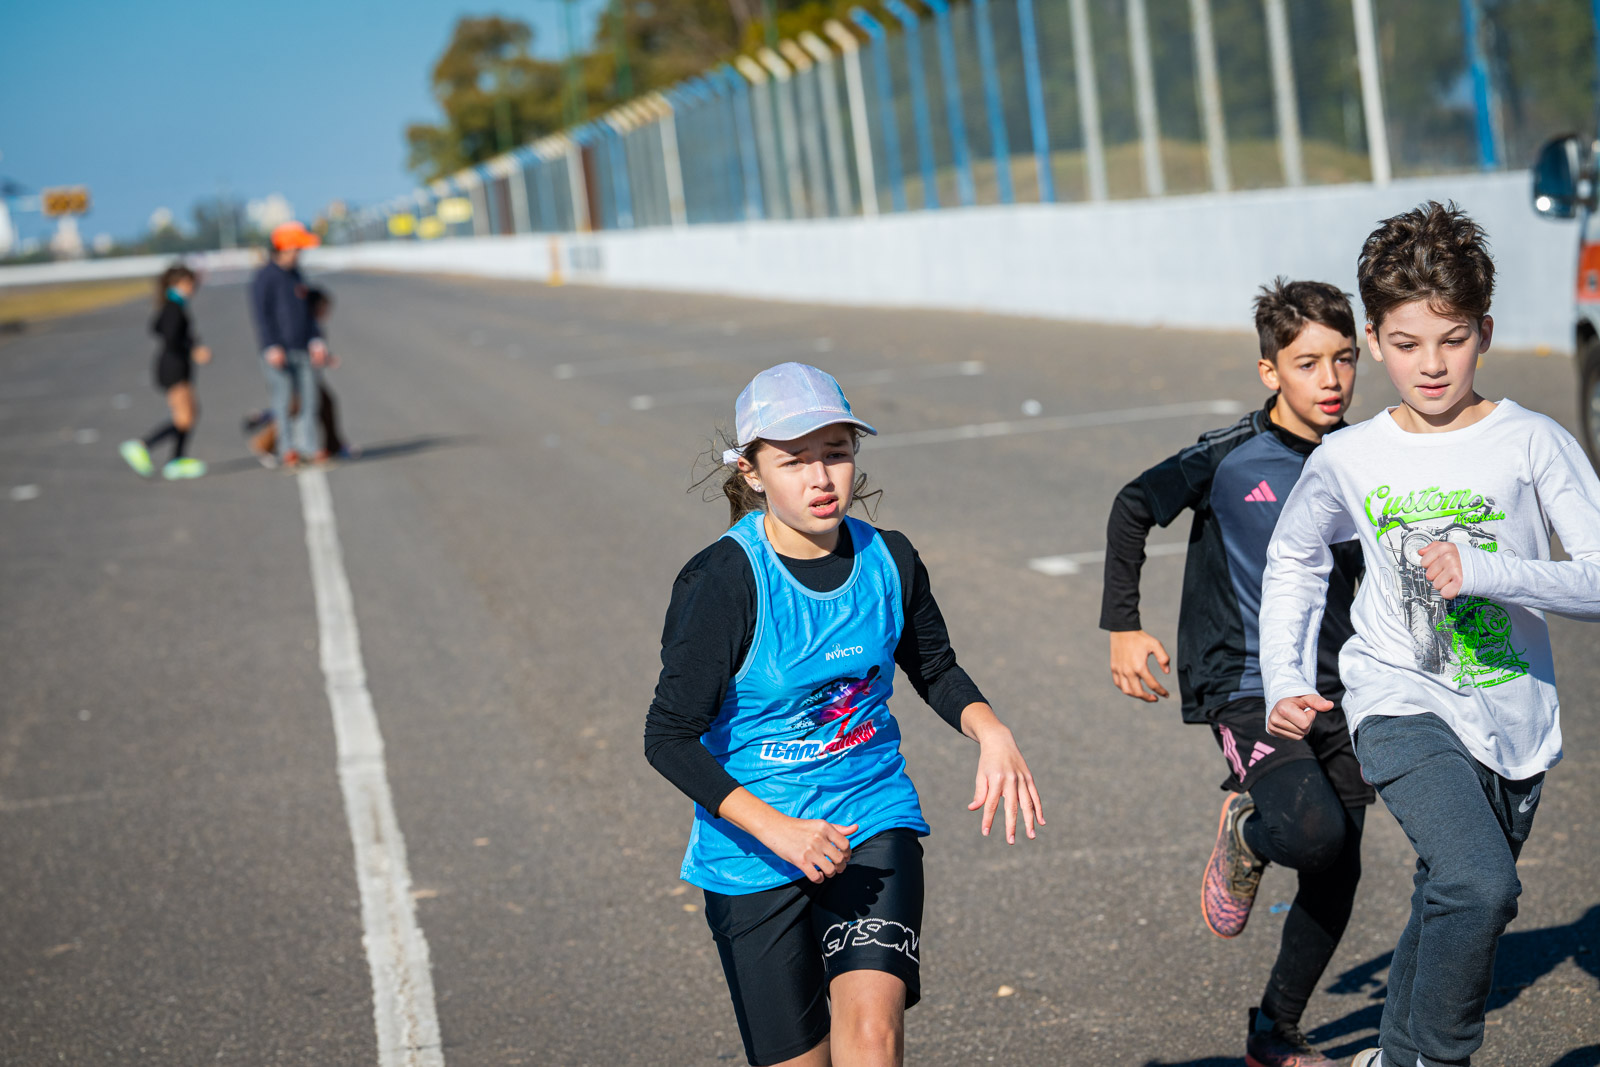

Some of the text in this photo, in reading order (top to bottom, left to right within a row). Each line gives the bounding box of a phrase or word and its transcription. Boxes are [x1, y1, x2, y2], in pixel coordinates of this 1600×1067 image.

[1365, 485, 1484, 530] Custom
[825, 645, 864, 661] INVICTO
[763, 741, 821, 761] TEAM
